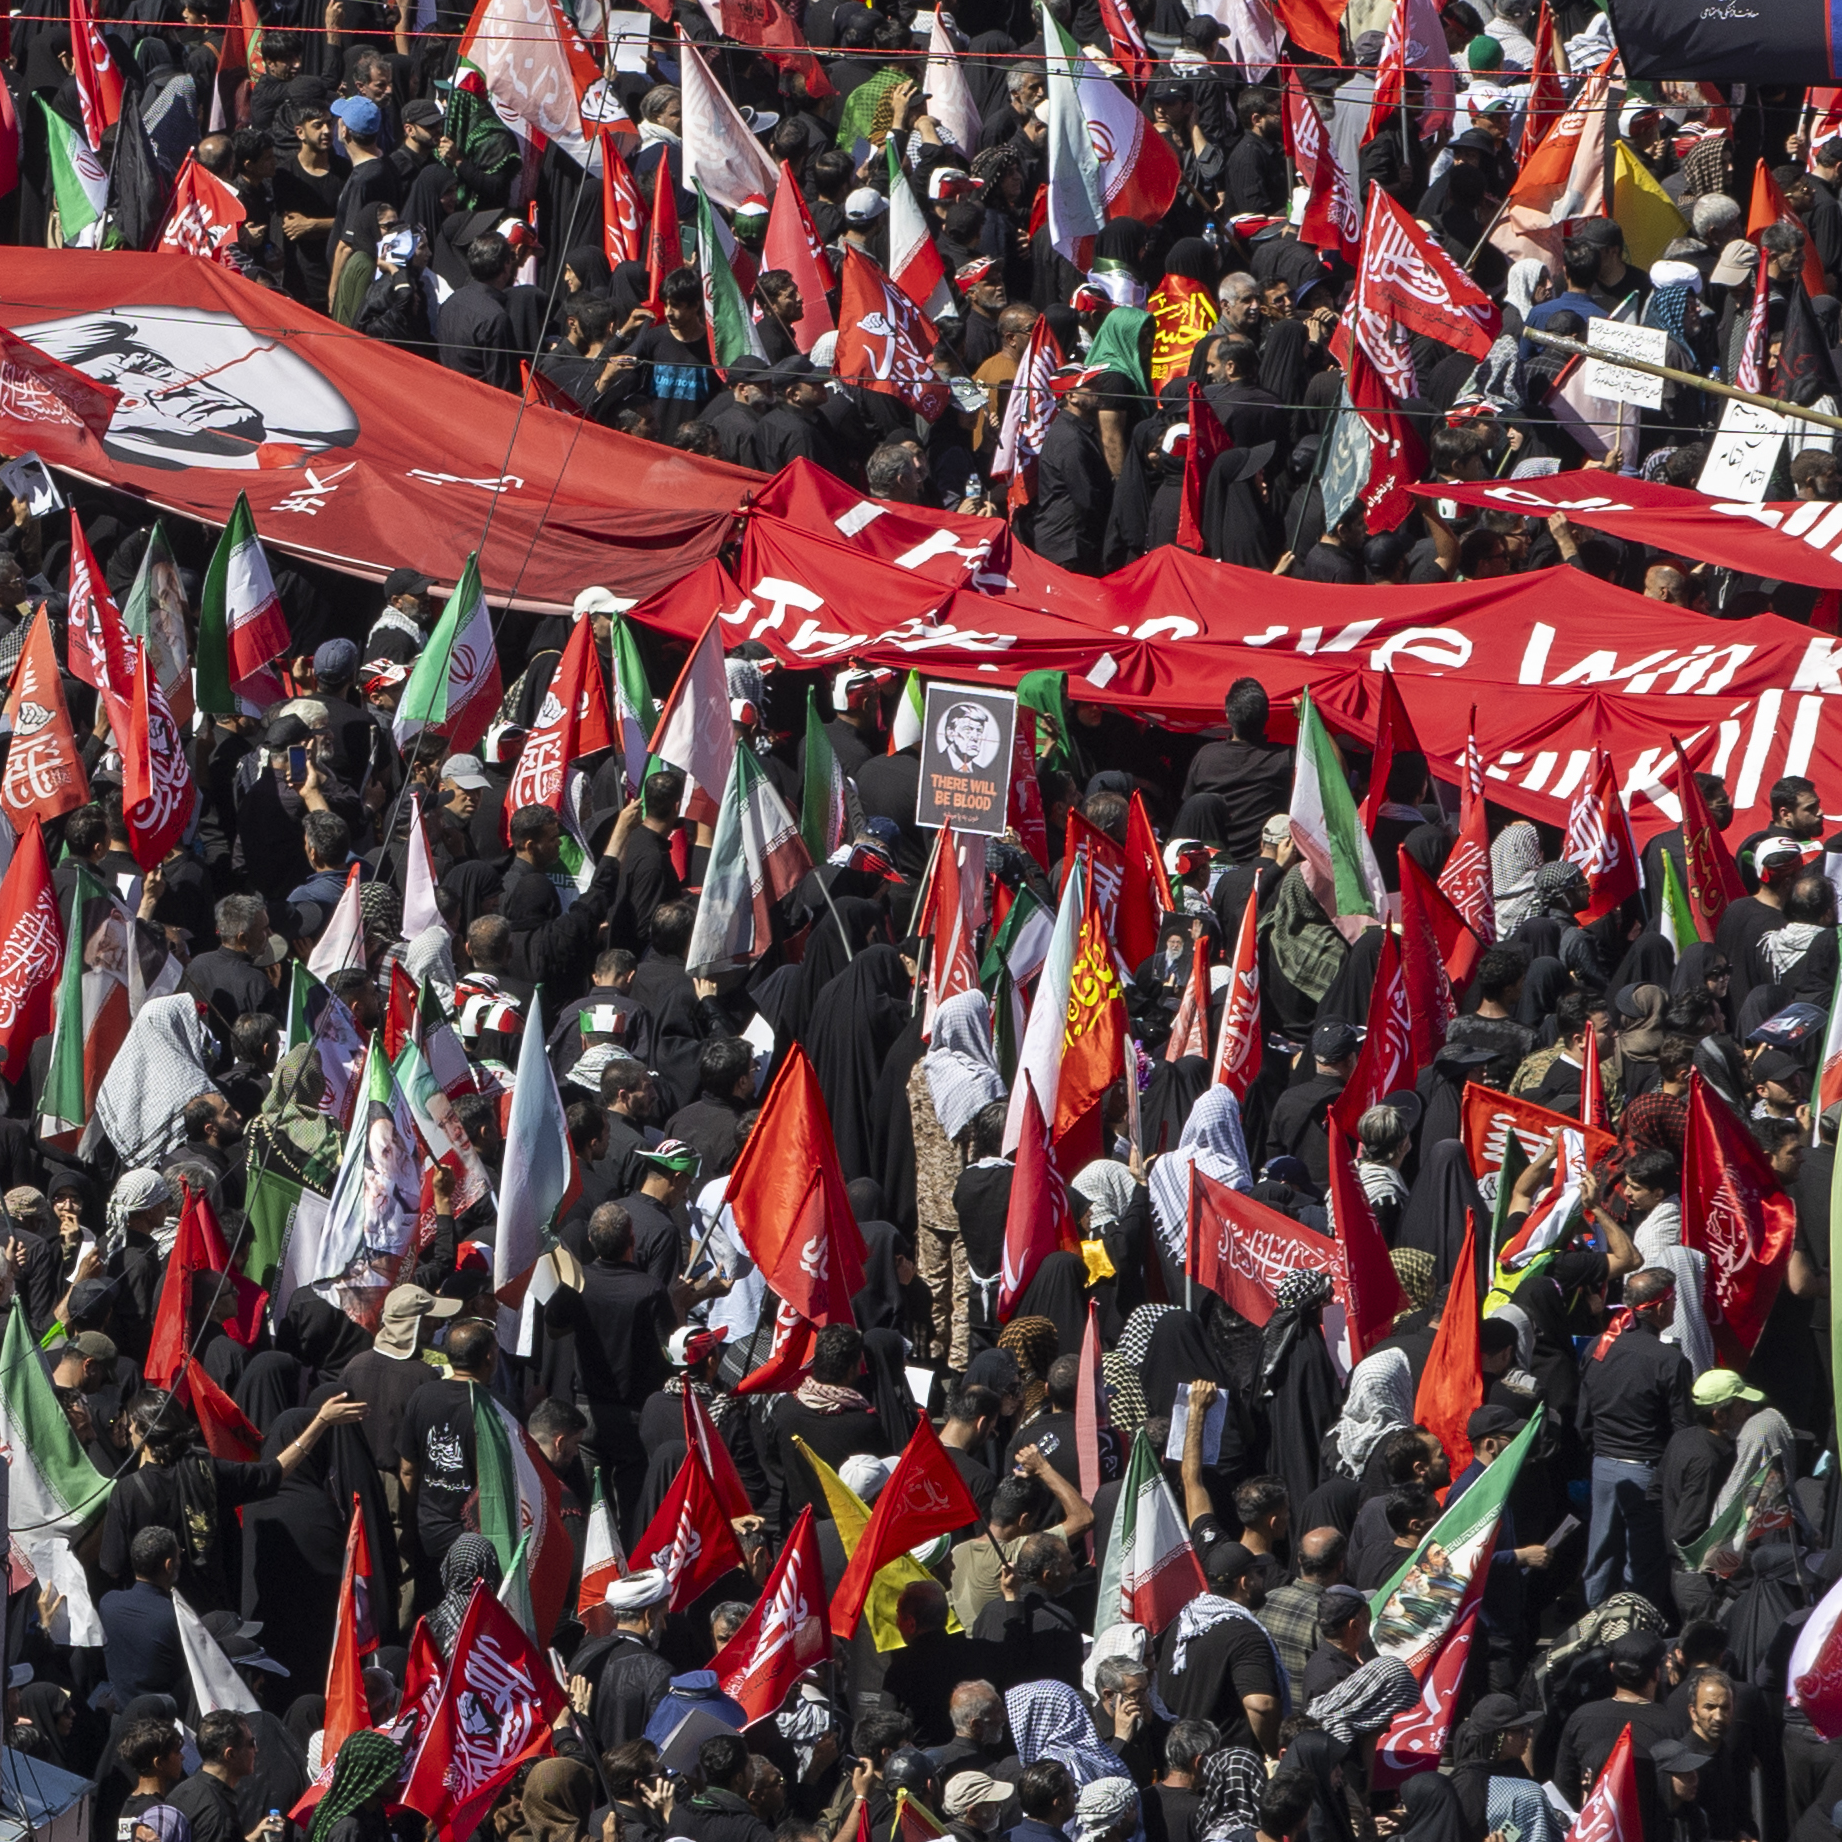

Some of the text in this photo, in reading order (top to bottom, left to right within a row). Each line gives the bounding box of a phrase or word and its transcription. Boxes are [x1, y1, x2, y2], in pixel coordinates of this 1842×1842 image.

[931, 774, 997, 797] THERE WILL
[934, 790, 993, 811] BE BLOOD
